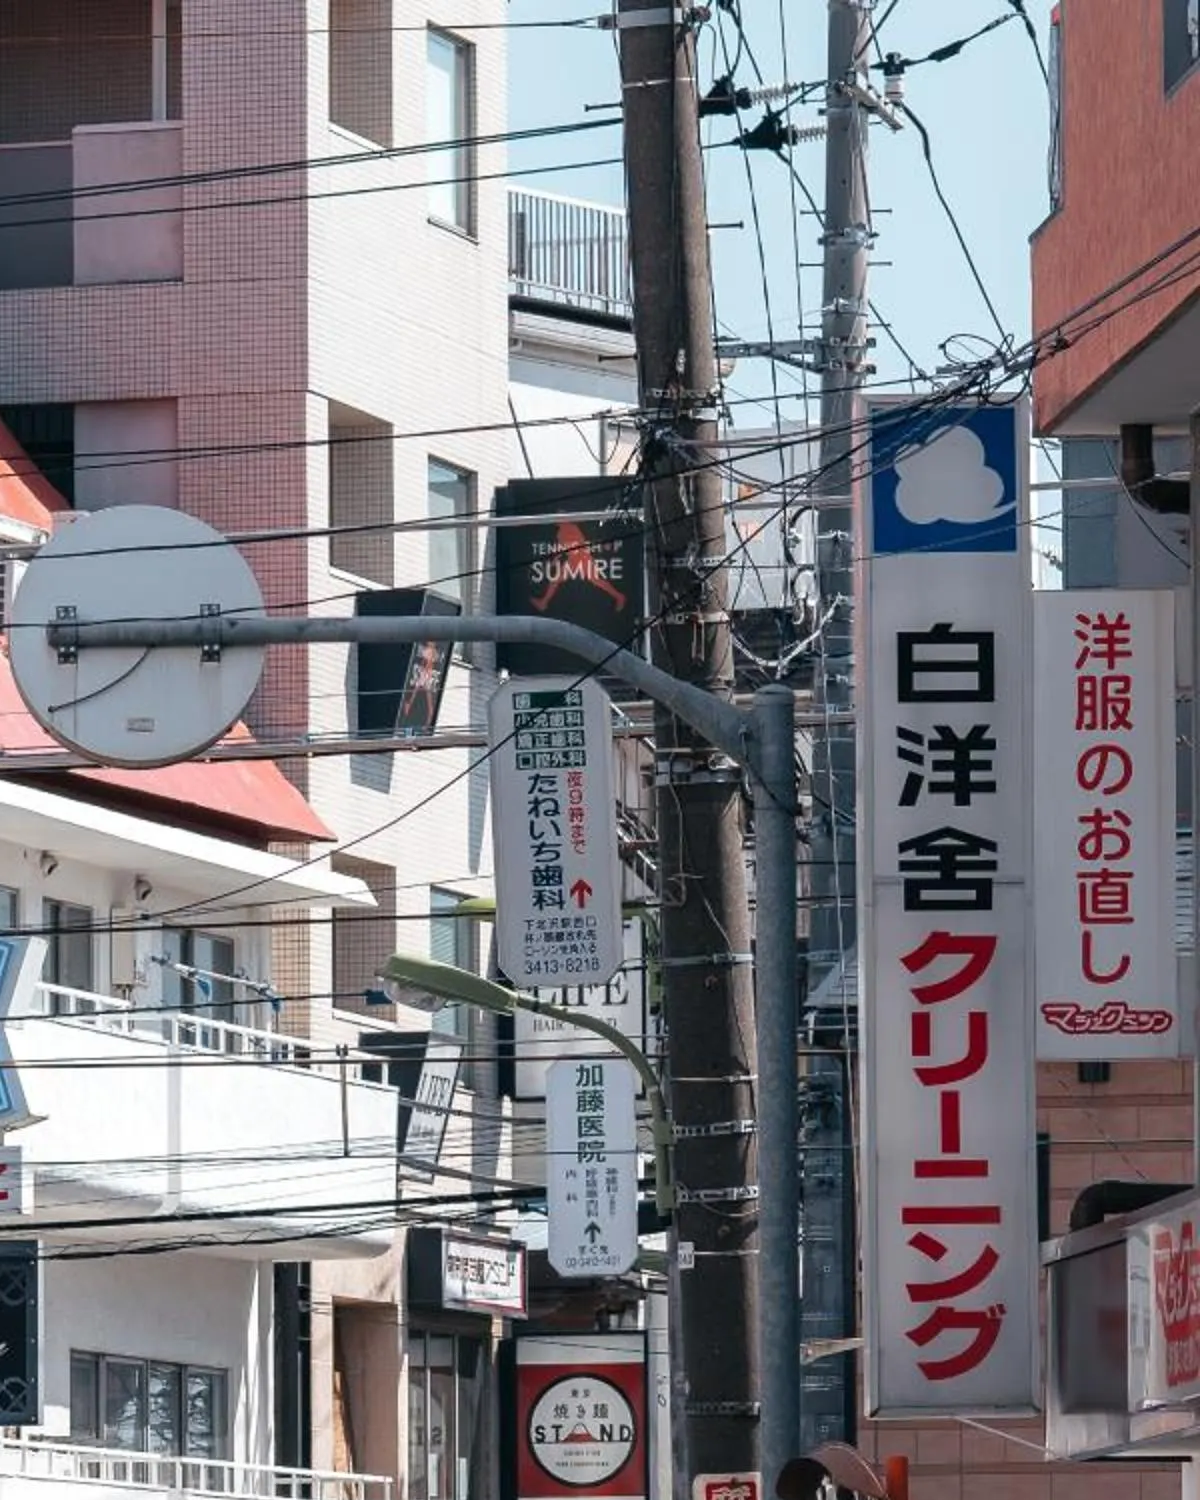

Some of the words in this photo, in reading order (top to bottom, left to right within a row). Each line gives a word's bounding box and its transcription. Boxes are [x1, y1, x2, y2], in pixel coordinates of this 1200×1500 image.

[531, 558, 623, 583] SUMIRE
[527, 772, 566, 911] たねいち歯科
[1074, 612, 1134, 985] 洋服のお直し
[575, 1063, 607, 1164] 加藤医院
[900, 931, 1006, 1381] クリーニング
